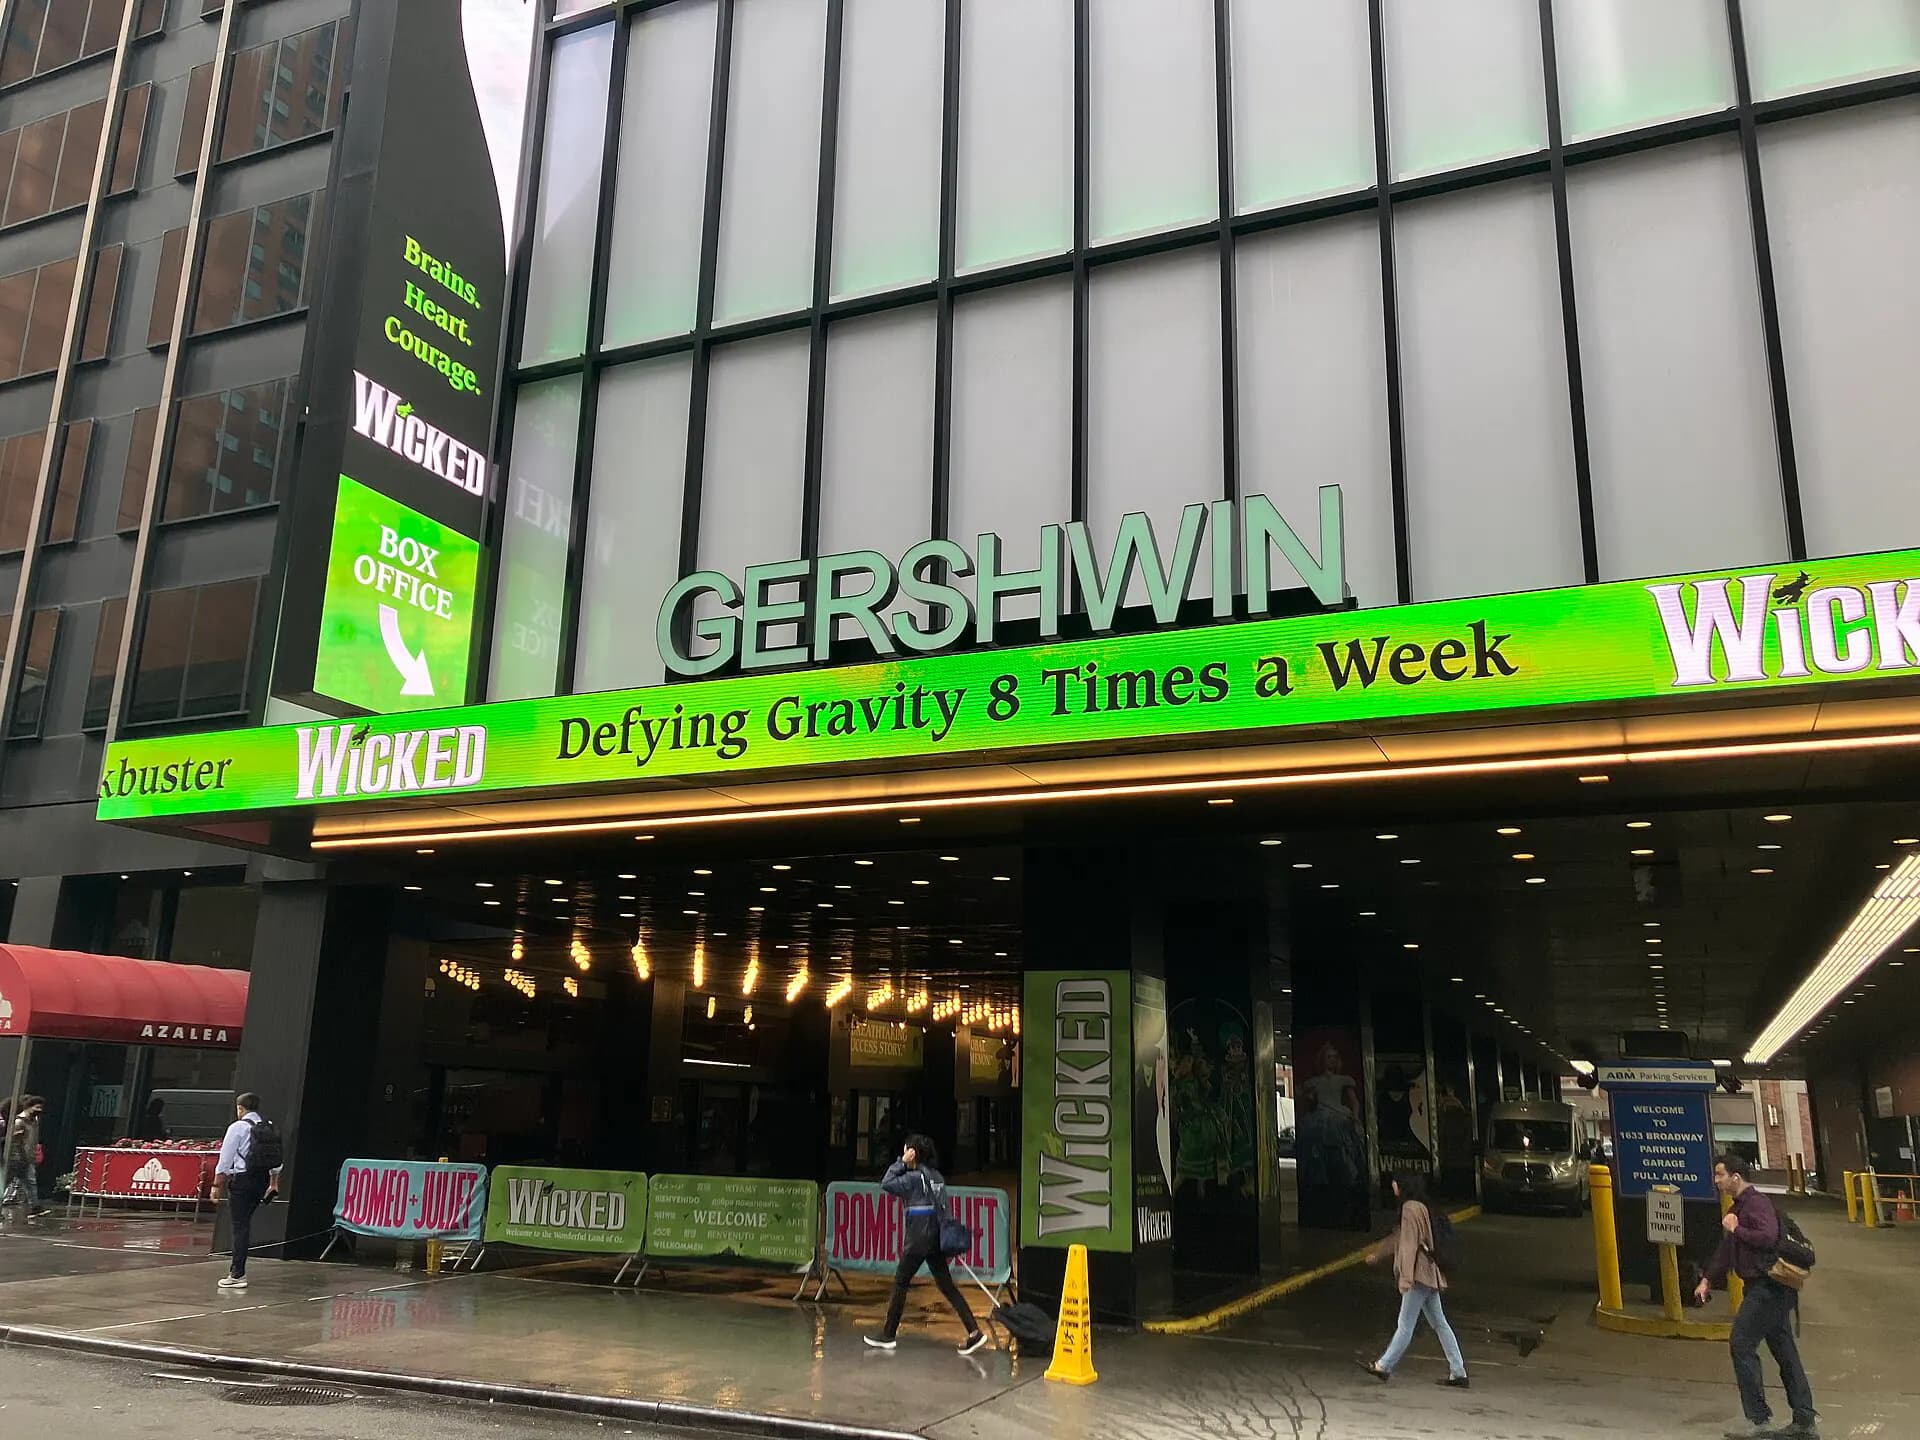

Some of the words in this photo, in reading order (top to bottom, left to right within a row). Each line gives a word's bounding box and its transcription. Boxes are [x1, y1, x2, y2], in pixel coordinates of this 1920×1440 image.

[404, 235, 480, 309] Brains.
[404, 280, 472, 346] Heart.
[384, 316, 481, 395] Courage.
[379, 524, 439, 578] BOX
[656, 484, 1348, 677] GERSHWIN
[353, 555, 453, 620] OFFICE
[556, 704, 751, 768] Defying
[767, 681, 968, 742] Gravity
[986, 673, 1021, 721] 8
[1041, 660, 1230, 717] Times
[1254, 656, 1294, 697] a
[1316, 618, 1520, 692] Week
[141, 1024, 228, 1042] AZALEA
[1607, 1072, 1636, 1080] ABM
[1640, 1072, 1671, 1082] Parking
[1673, 1073, 1708, 1081] Services
[1633, 1106, 1685, 1114] WELCOME
[1653, 1119, 1667, 1127] TO
[1620, 1132, 1644, 1140] 1633
[1646, 1132, 1704, 1142] BROADWAY
[1640, 1146, 1686, 1154] PARKING
[1642, 1159, 1685, 1168] GARAGE
[1633, 1172, 1659, 1181] PULL
[1662, 1173, 1698, 1181] AHEAD
[131, 1181, 170, 1191] AZALEA
[341, 1167, 410, 1227] ROMEO
[413, 1170, 478, 1230] JULIET
[1659, 1201, 1670, 1209] NO
[694, 1209, 768, 1228] WELCOME
[1655, 1211, 1676, 1221] THRU
[1650, 1222, 1681, 1233] TRAFFIC
[505, 1228, 533, 1237] Welcome
[542, 1229, 552, 1239] the
[553, 1231, 587, 1241] Wonderful
[588, 1233, 604, 1242] Land
[606, 1234, 613, 1242] of
